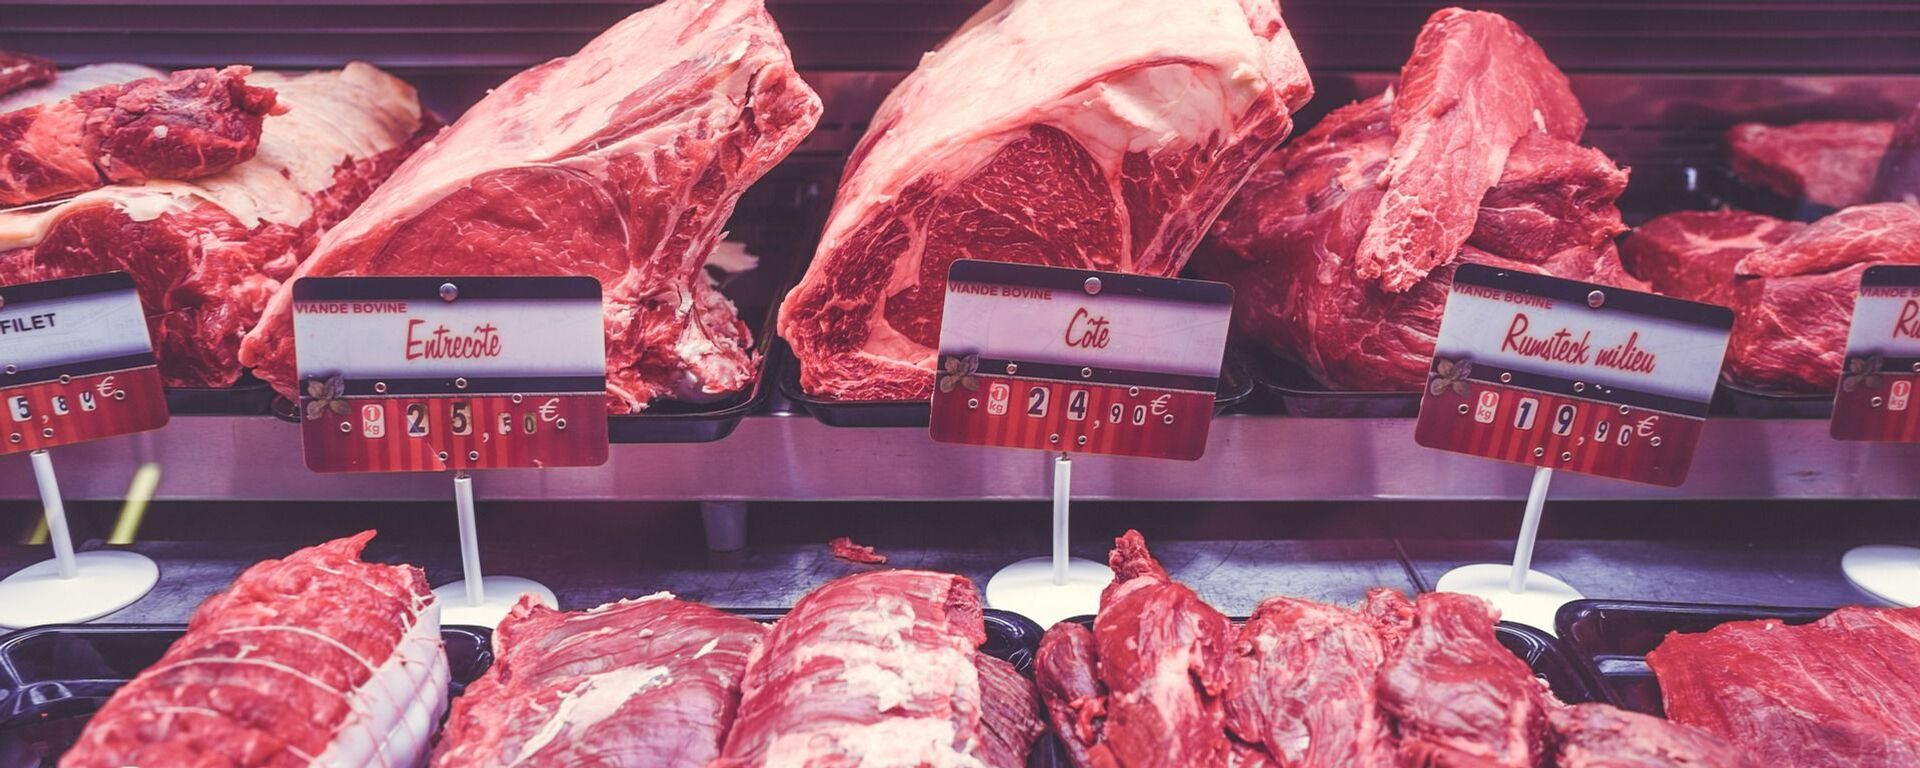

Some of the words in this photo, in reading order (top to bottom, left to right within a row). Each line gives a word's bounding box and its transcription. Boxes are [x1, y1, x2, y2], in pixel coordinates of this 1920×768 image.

[949, 283, 998, 296] VIANDE
[1002, 287, 1052, 300] BOVINE
[1452, 285, 1500, 300] VIANDE
[1504, 292, 1553, 310] BOVINE
[1861, 288, 1907, 297] VIANDE
[295, 303, 348, 313] VIANDE
[353, 303, 407, 313] BOVINE
[1065, 307, 1111, 349] Côte
[405, 319, 502, 360] Entrecôte
[1501, 313, 1591, 364] Rumsteck
[1595, 332, 1656, 374] milieu
[989, 400, 1004, 413] kg
[1477, 407, 1492, 420] kg
[364, 423, 380, 435] kg
